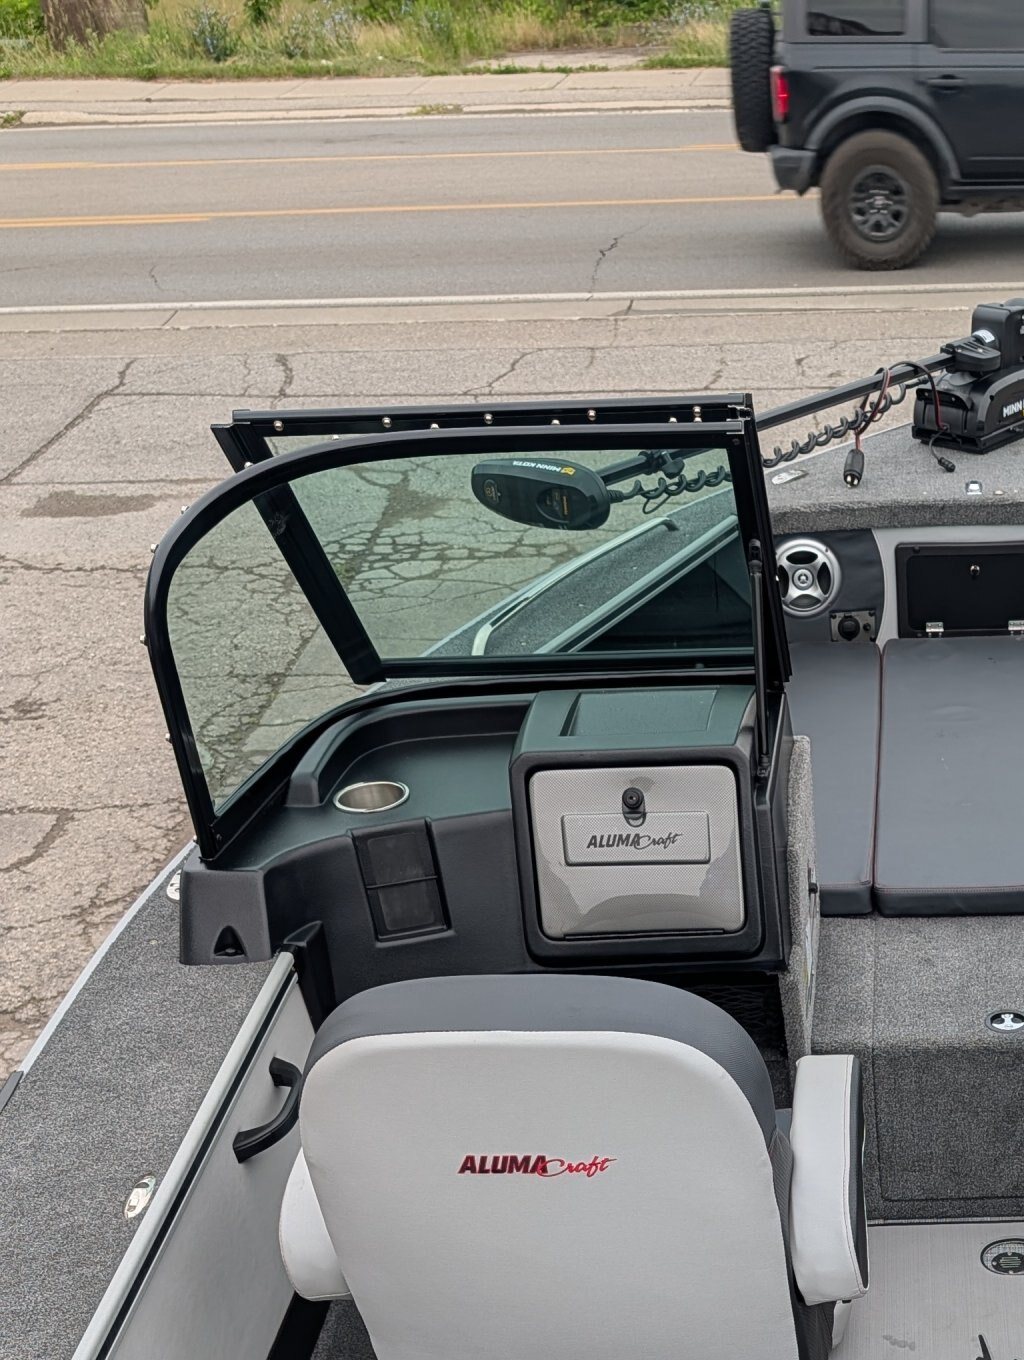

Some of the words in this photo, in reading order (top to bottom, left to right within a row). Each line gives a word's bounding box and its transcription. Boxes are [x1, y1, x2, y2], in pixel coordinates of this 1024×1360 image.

[1003, 400, 1022, 418] MINN
[512, 460, 536, 468] KOTA
[536, 463, 561, 472] MINN
